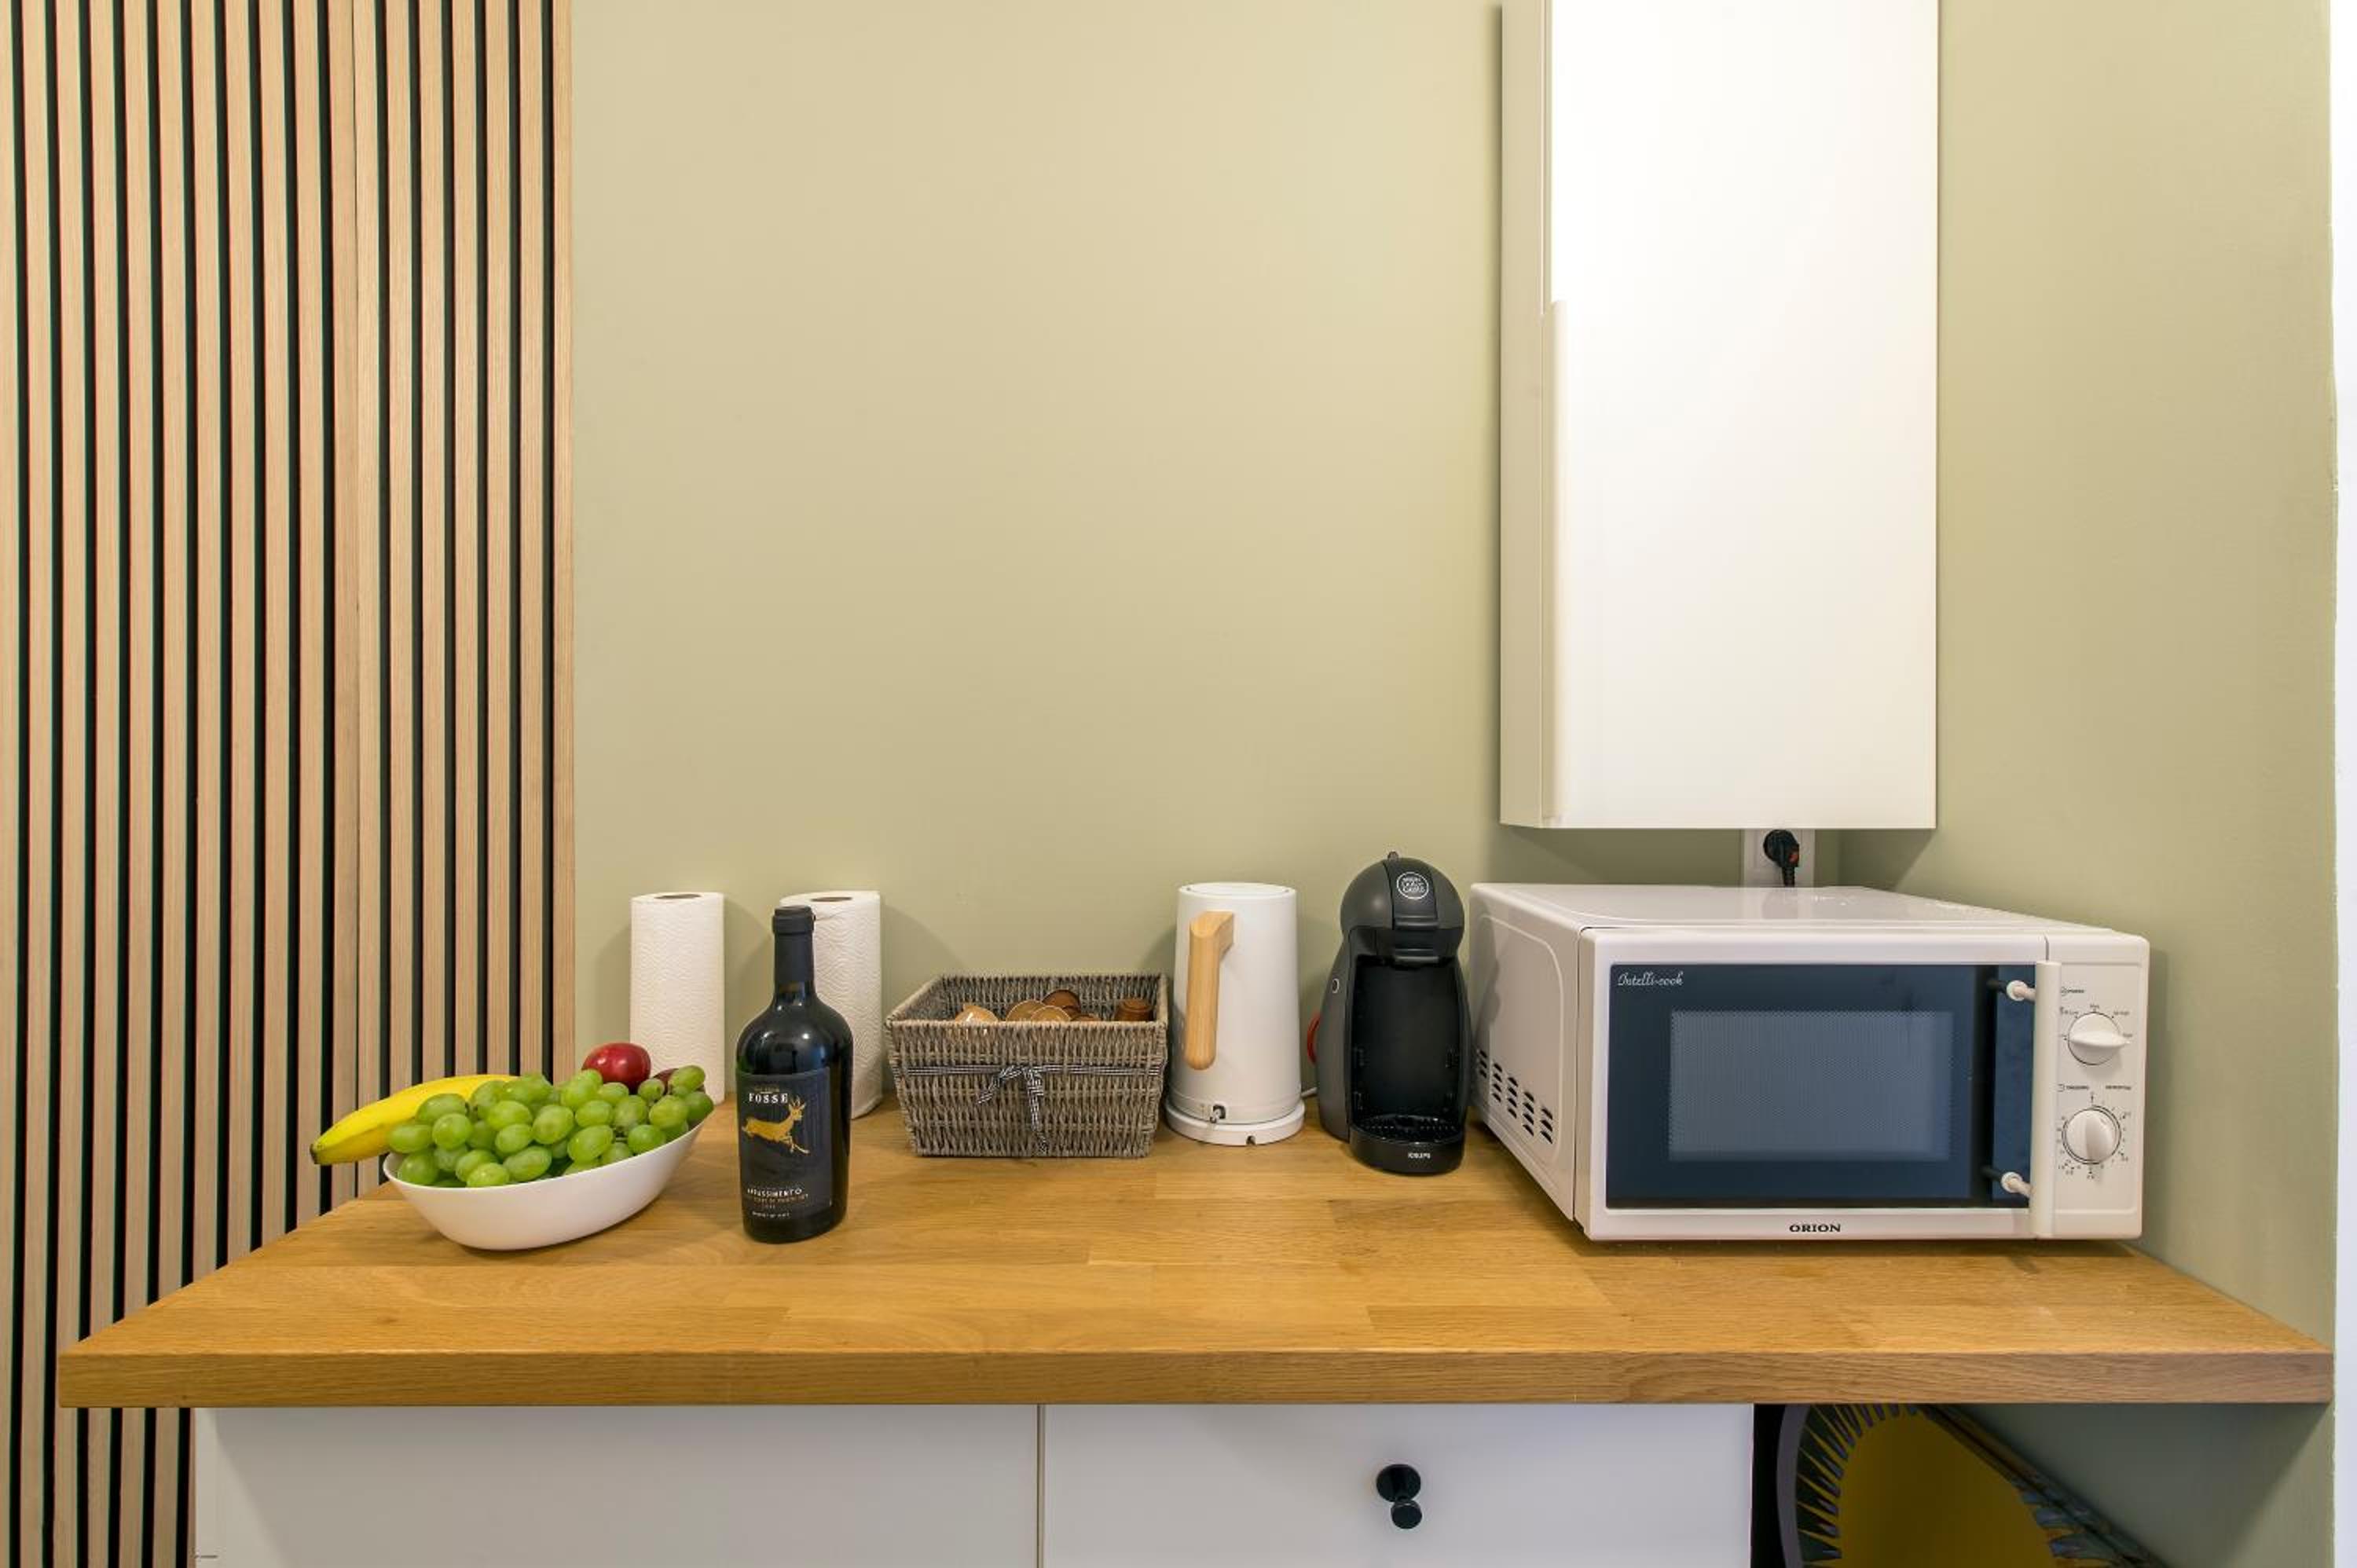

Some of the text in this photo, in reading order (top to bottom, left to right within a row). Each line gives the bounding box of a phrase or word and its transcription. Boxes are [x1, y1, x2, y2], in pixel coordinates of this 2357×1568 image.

[1618, 970, 1684, 986] Intelli-cook
[749, 1093, 788, 1104] FOSSE
[1789, 1223, 1841, 1233] ORION
